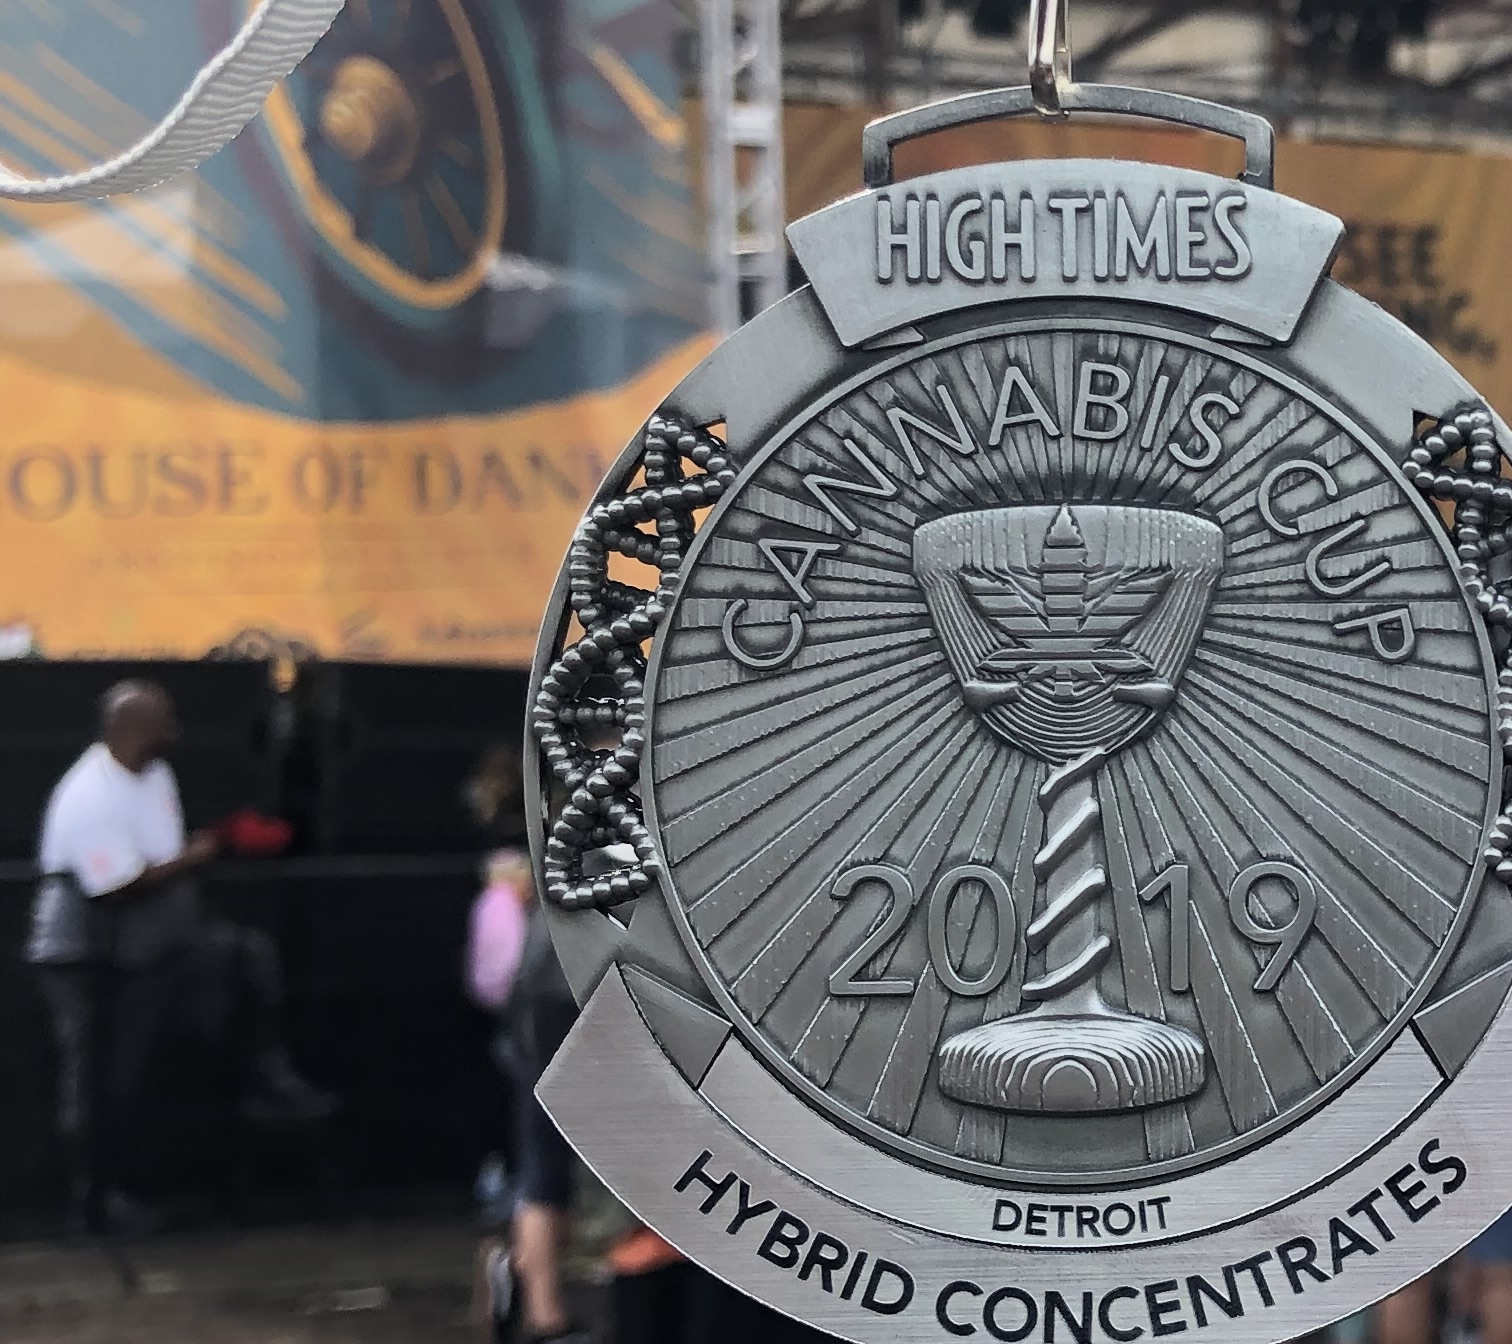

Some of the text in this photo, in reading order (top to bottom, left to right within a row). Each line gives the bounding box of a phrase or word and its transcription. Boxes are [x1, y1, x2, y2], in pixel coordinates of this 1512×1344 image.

[875, 189, 1254, 286] HIGH TIMES
[722, 360, 1418, 672] CANNABIS CUP
[672, 1146, 916, 1319] HYBRID
[991, 1195, 1172, 1240] DETROIT
